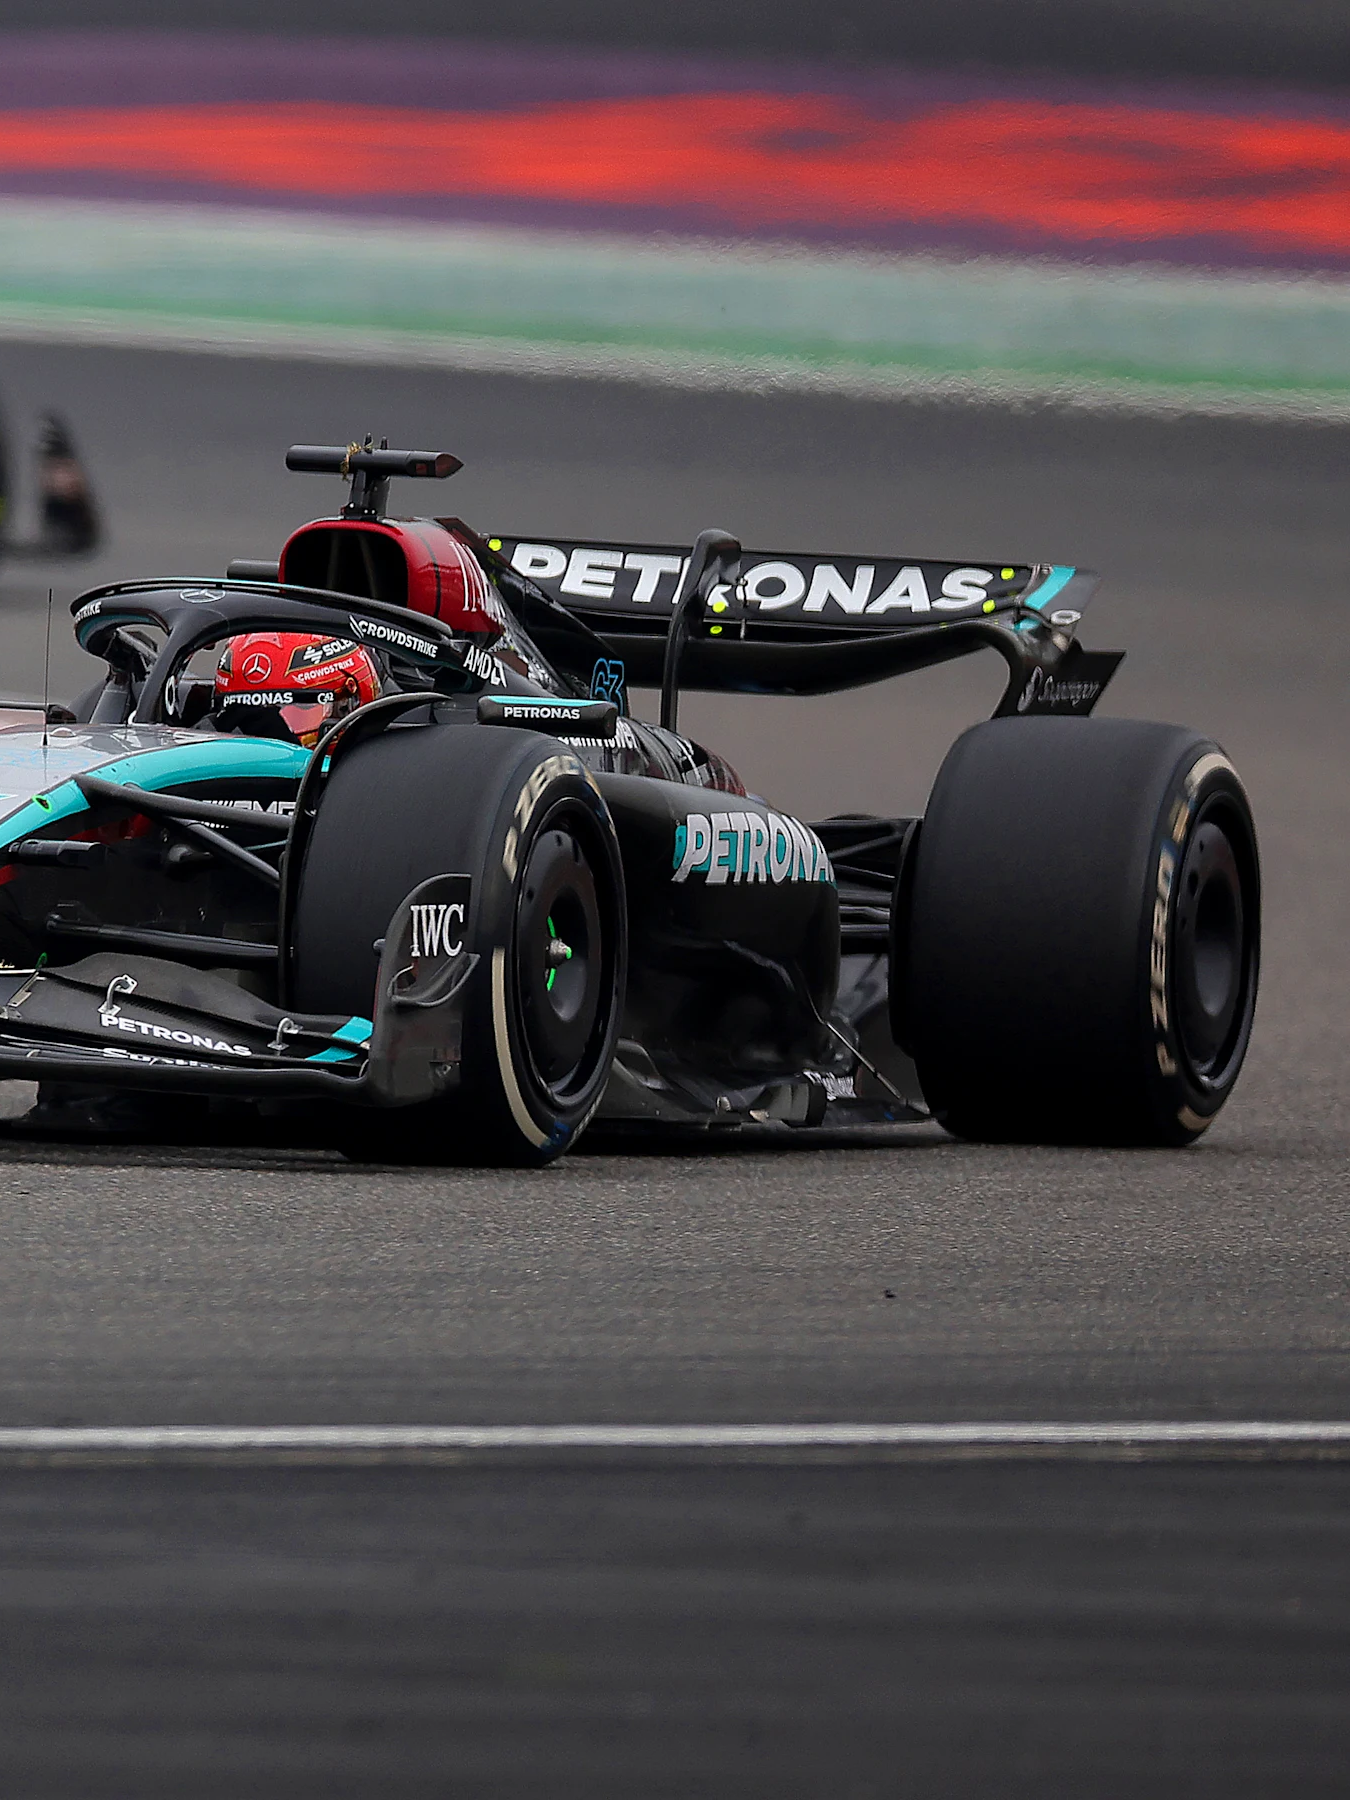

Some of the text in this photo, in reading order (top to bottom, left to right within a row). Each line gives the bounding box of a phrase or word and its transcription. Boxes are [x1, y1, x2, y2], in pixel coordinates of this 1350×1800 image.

[322, 638, 354, 657] SOLE
[359, 620, 439, 659] CROWDSTRIKE
[298, 657, 355, 682] CROWDSTRIKE
[463, 644, 492, 680] AMD
[590, 658, 625, 716] 63
[503, 706, 581, 720] PETRONAS
[671, 812, 836, 885] PETRONA
[410, 903, 464, 957] IWC
[101, 1013, 253, 1057] PETRONAS
